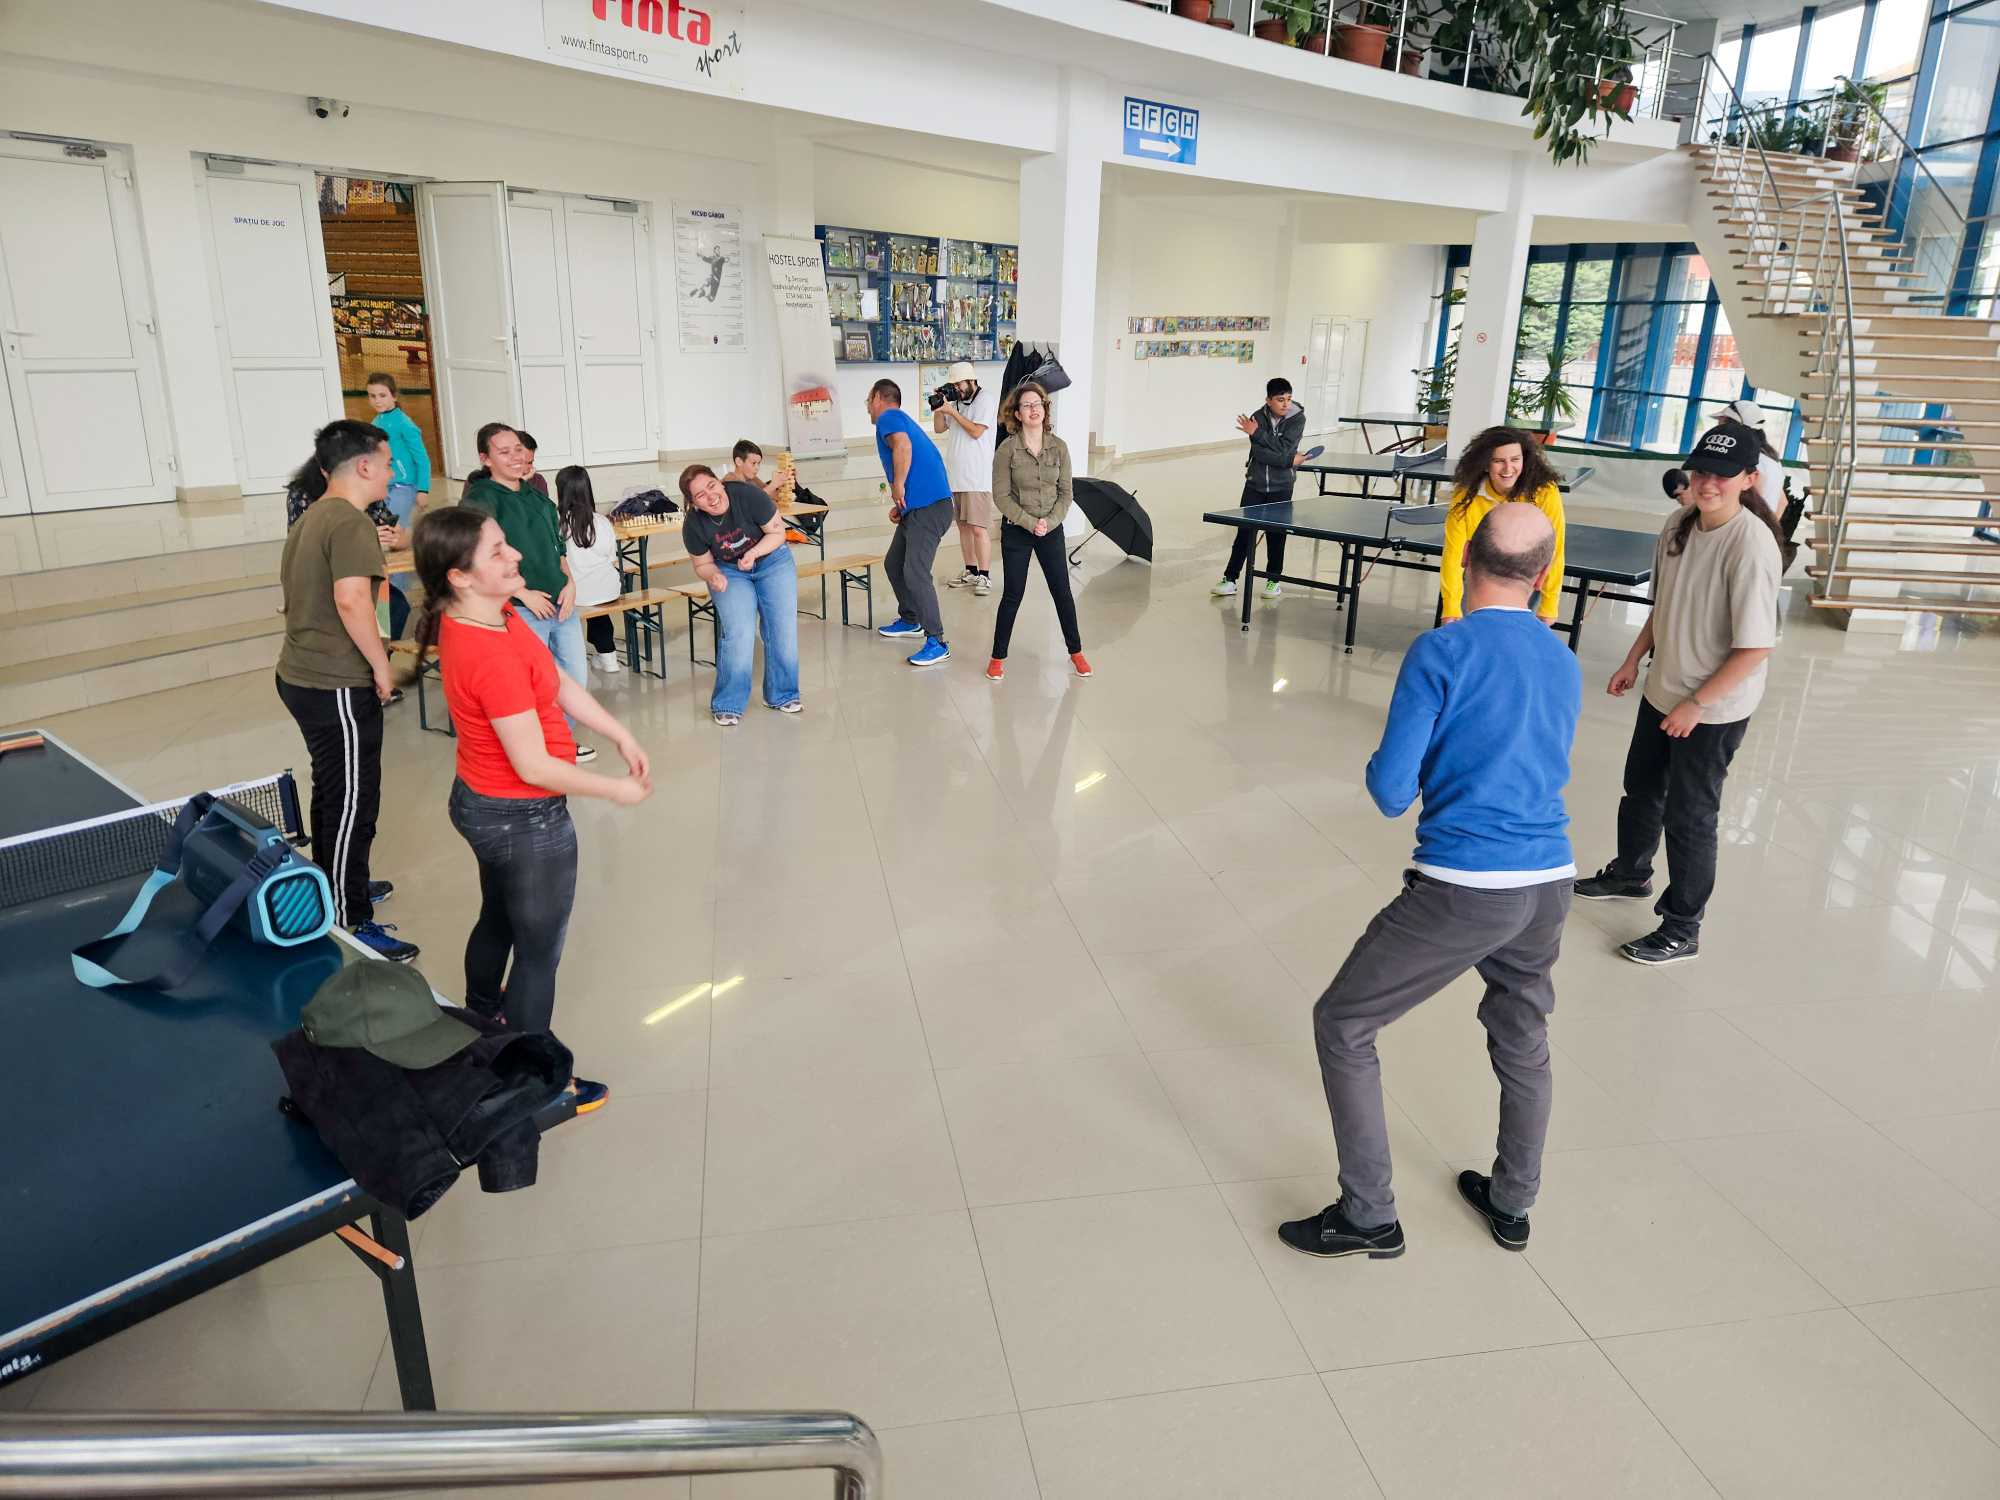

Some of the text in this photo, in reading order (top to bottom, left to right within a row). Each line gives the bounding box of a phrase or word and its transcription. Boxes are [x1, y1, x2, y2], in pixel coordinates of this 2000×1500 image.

[561, 34, 649, 65] www.fintasport.ro
[695, 30, 742, 77] sport
[271, 219, 286, 227] JOC
[768, 253, 819, 268] HOSTEL SPORT
[1705, 444, 1728, 454] Audi
